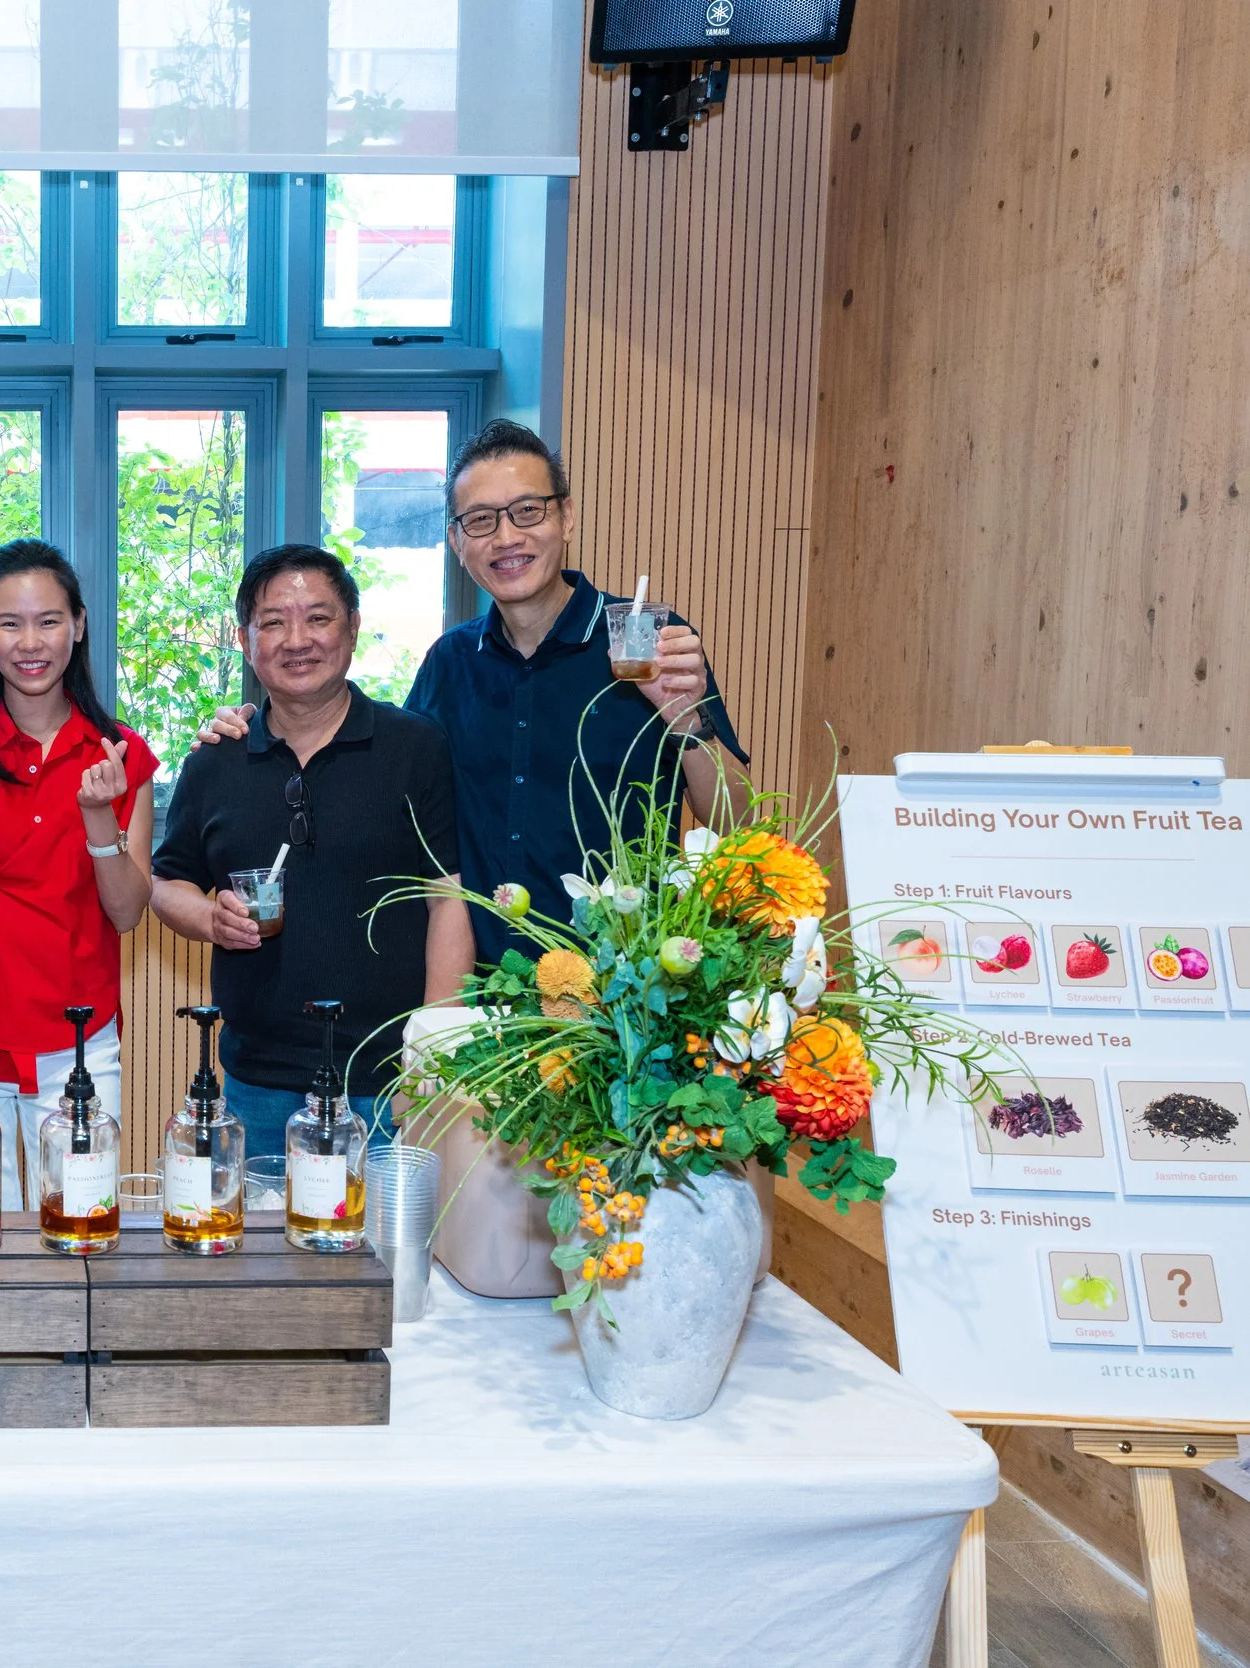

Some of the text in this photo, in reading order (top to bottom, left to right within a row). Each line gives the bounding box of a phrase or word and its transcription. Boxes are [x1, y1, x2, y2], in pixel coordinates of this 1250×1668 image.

[705, 28, 730, 36] YAMAHA
[894, 807, 1243, 832] Building Your Own Fruit Tea
[894, 883, 1072, 901] Step 1: Fruit Flavours
[990, 989, 1026, 1000] Lychee
[1066, 992, 1123, 1005] Strawberry
[1153, 994, 1214, 1006] Passionfruit
[911, 1028, 952, 1046] Step
[977, 1029, 1093, 1046] Cold-Brewed
[1097, 1033, 1132, 1047] Tea
[1022, 1165, 1062, 1177] Roselle
[1154, 1171, 1238, 1182] Jasmine Garden
[172, 1175, 193, 1185] PEACH
[932, 1208, 1091, 1231] Step 3: Finishings
[1075, 1327, 1115, 1339] Grapes
[1171, 1329, 1207, 1340] Secret
[1101, 1364, 1196, 1380] arteasan
